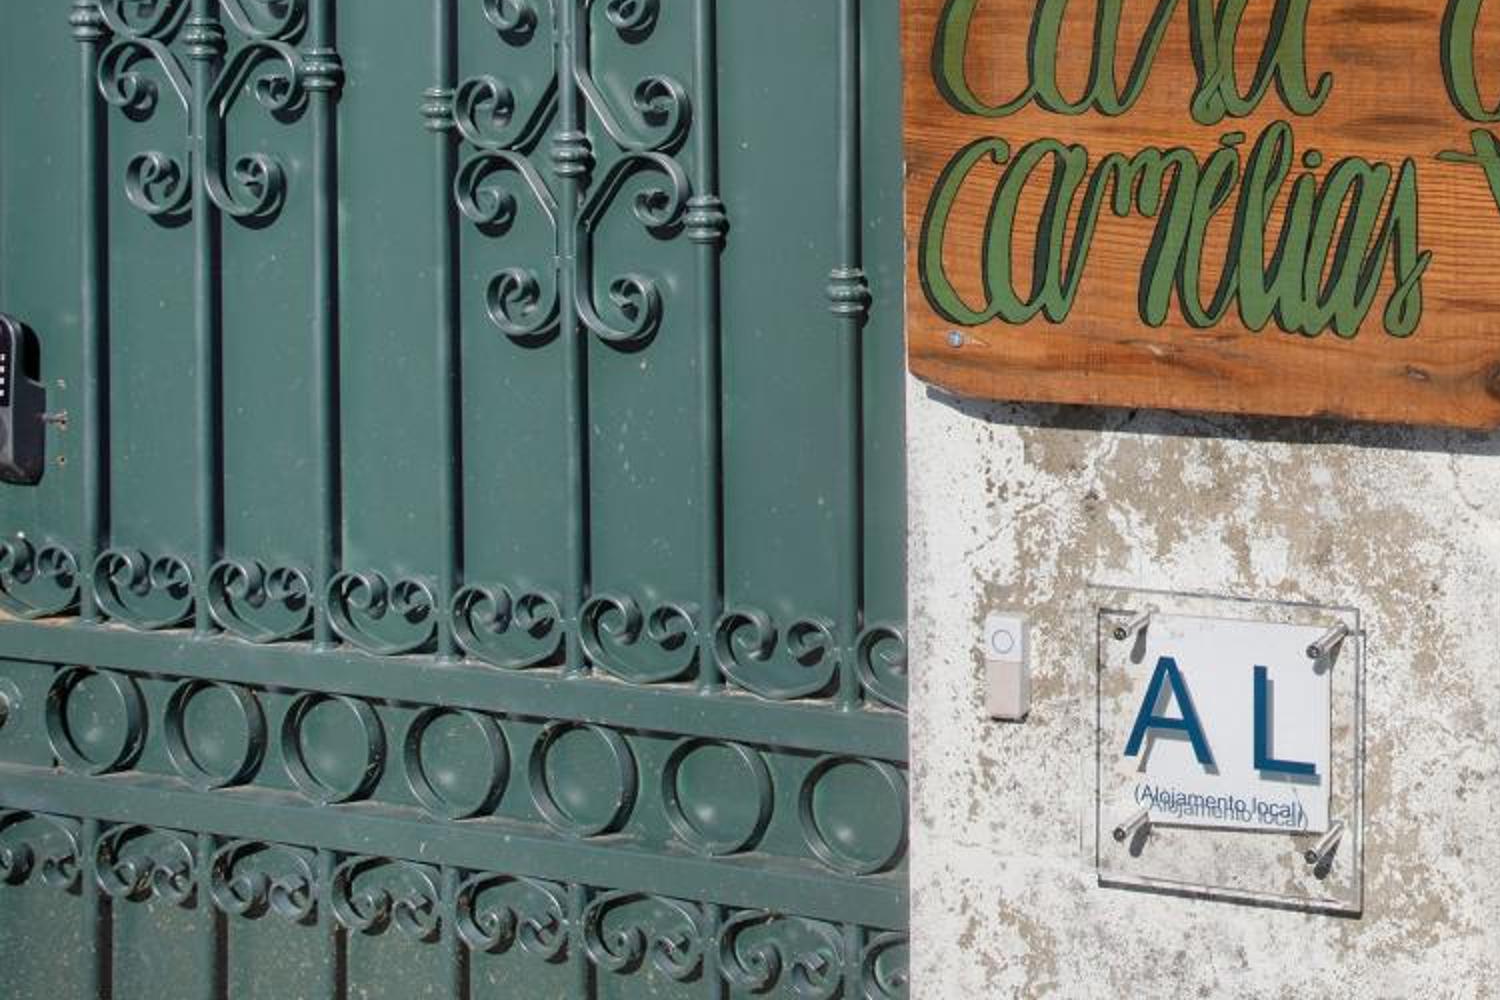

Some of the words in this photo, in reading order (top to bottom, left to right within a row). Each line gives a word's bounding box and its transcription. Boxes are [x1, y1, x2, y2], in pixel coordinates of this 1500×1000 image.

[918, 119, 1433, 338] camélias
[1134, 783, 1247, 813] (Alojamento
[1251, 797, 1303, 823] local)
